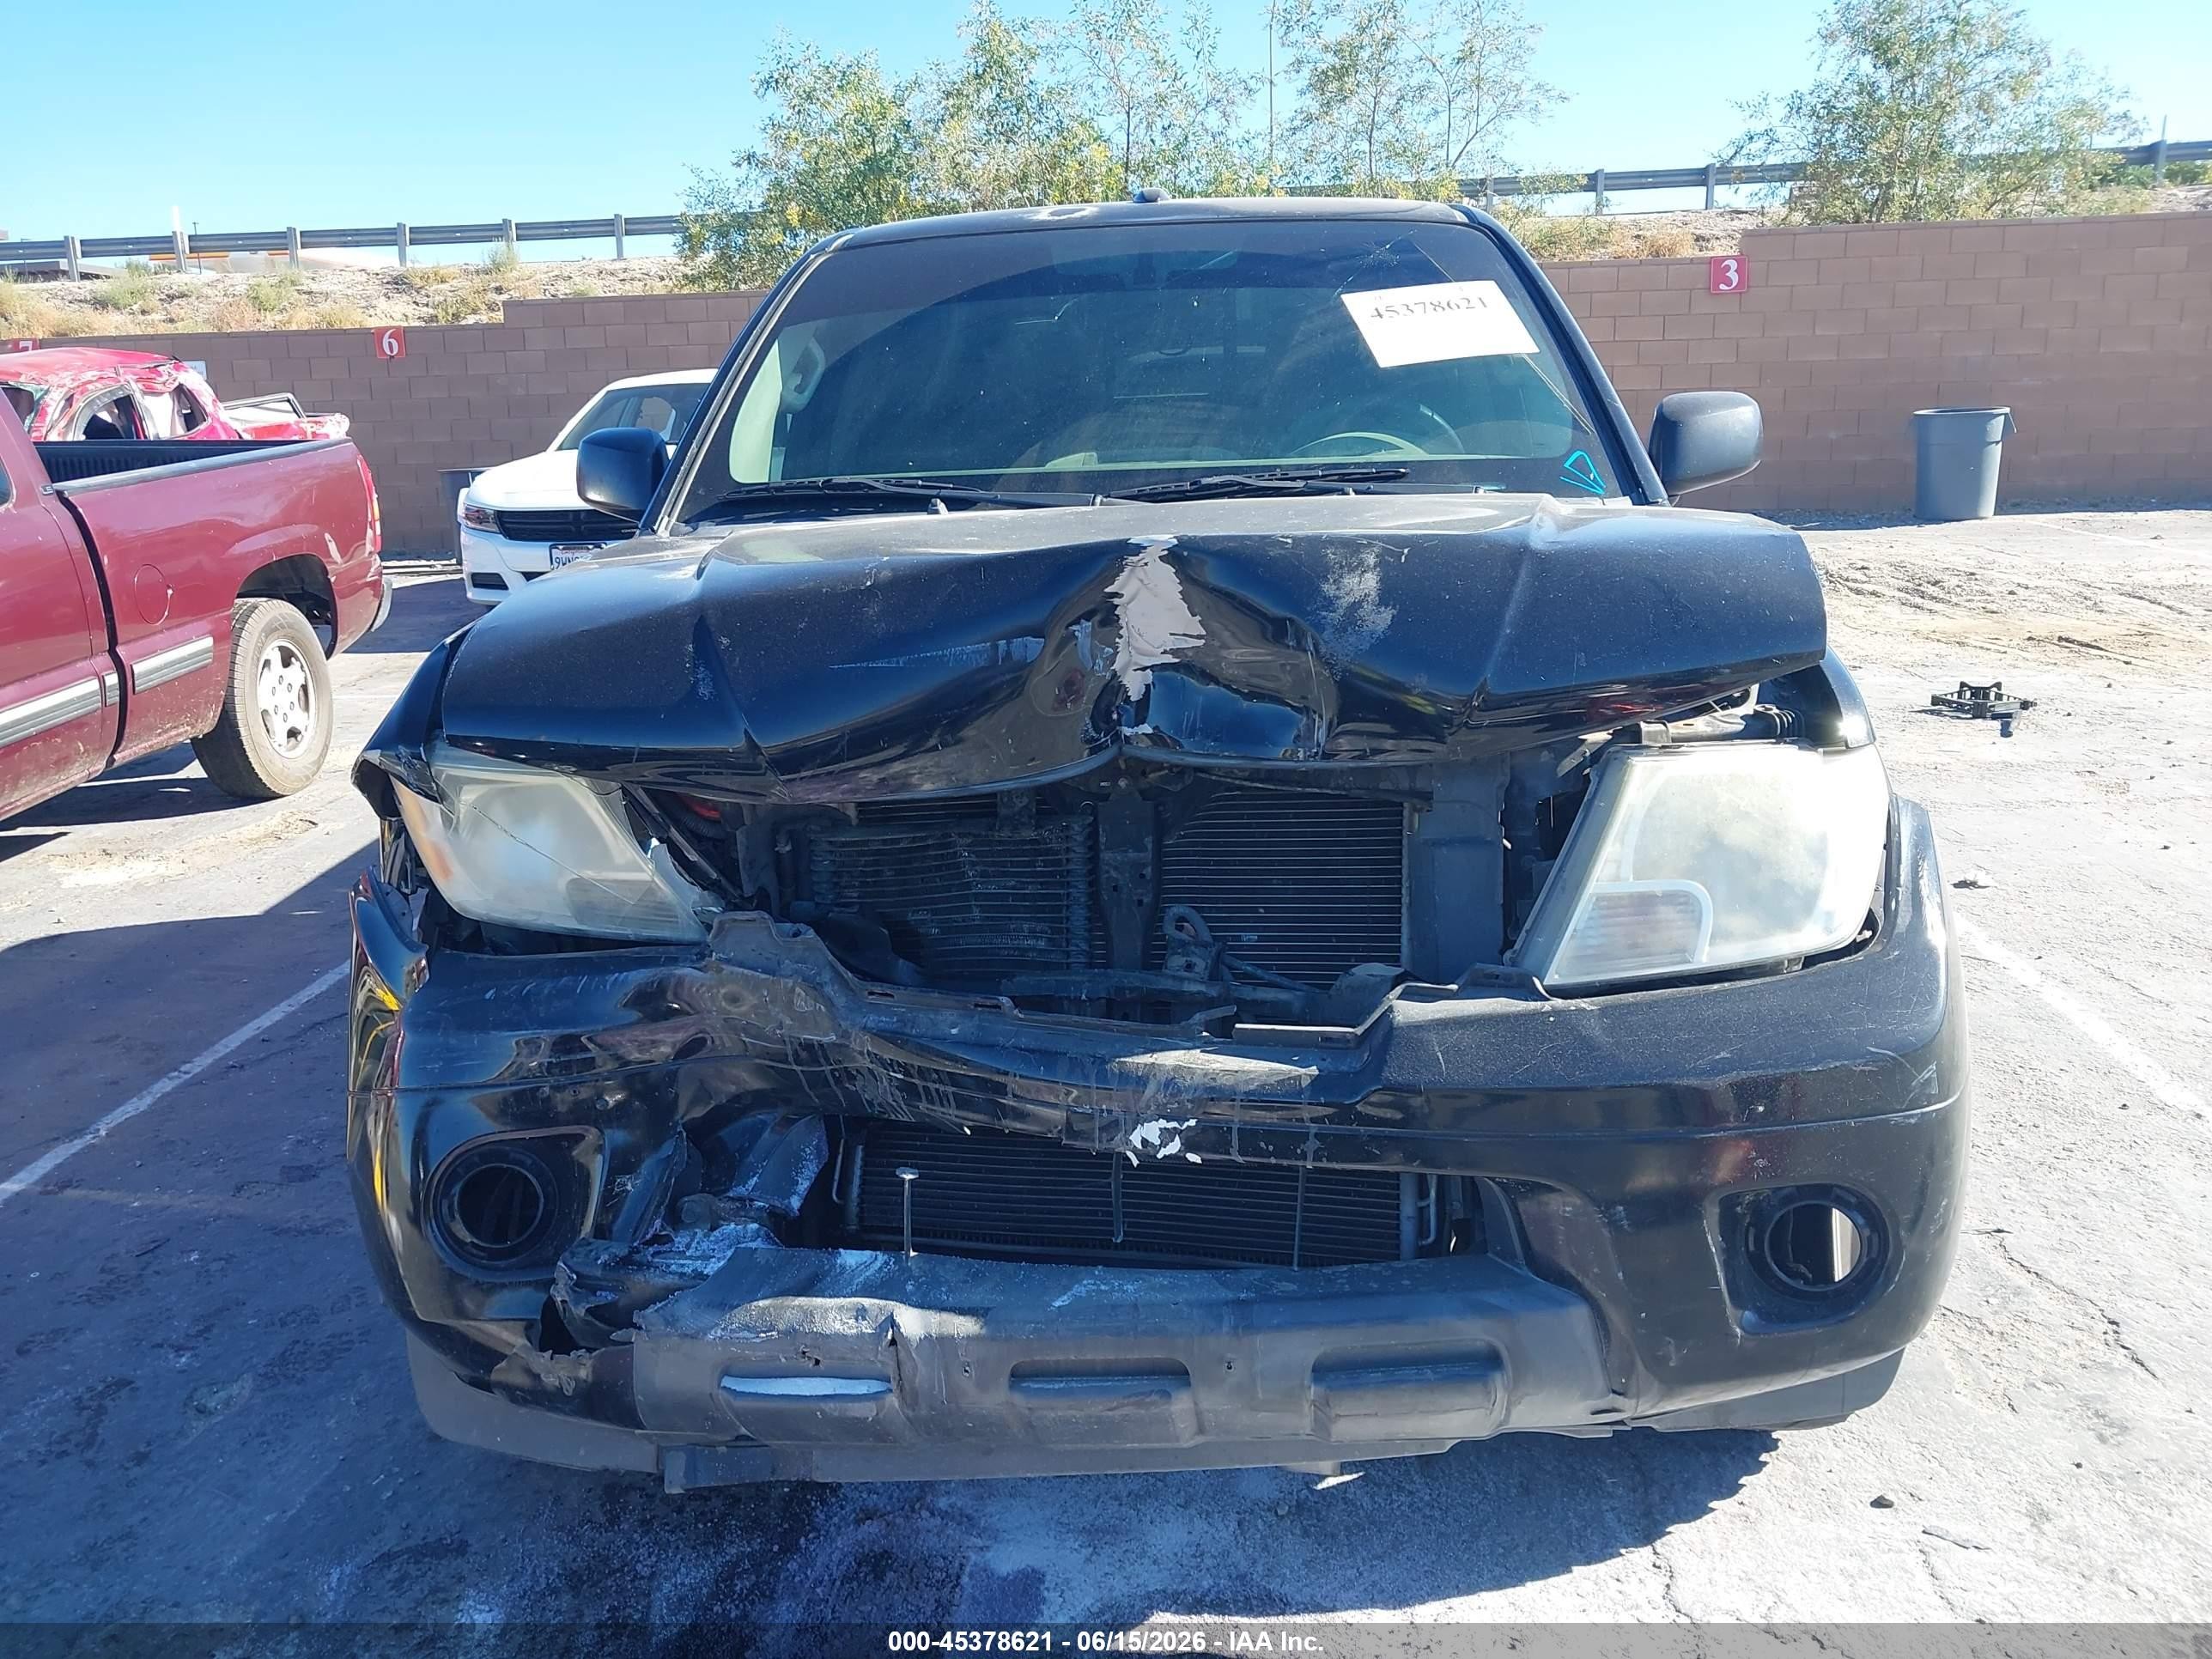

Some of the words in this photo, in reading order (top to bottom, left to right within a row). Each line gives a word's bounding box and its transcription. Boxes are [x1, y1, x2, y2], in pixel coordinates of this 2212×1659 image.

[1719, 259, 1739, 289] 3
[1370, 297, 1487, 319] 45378621
[383, 329, 398, 356] 6
